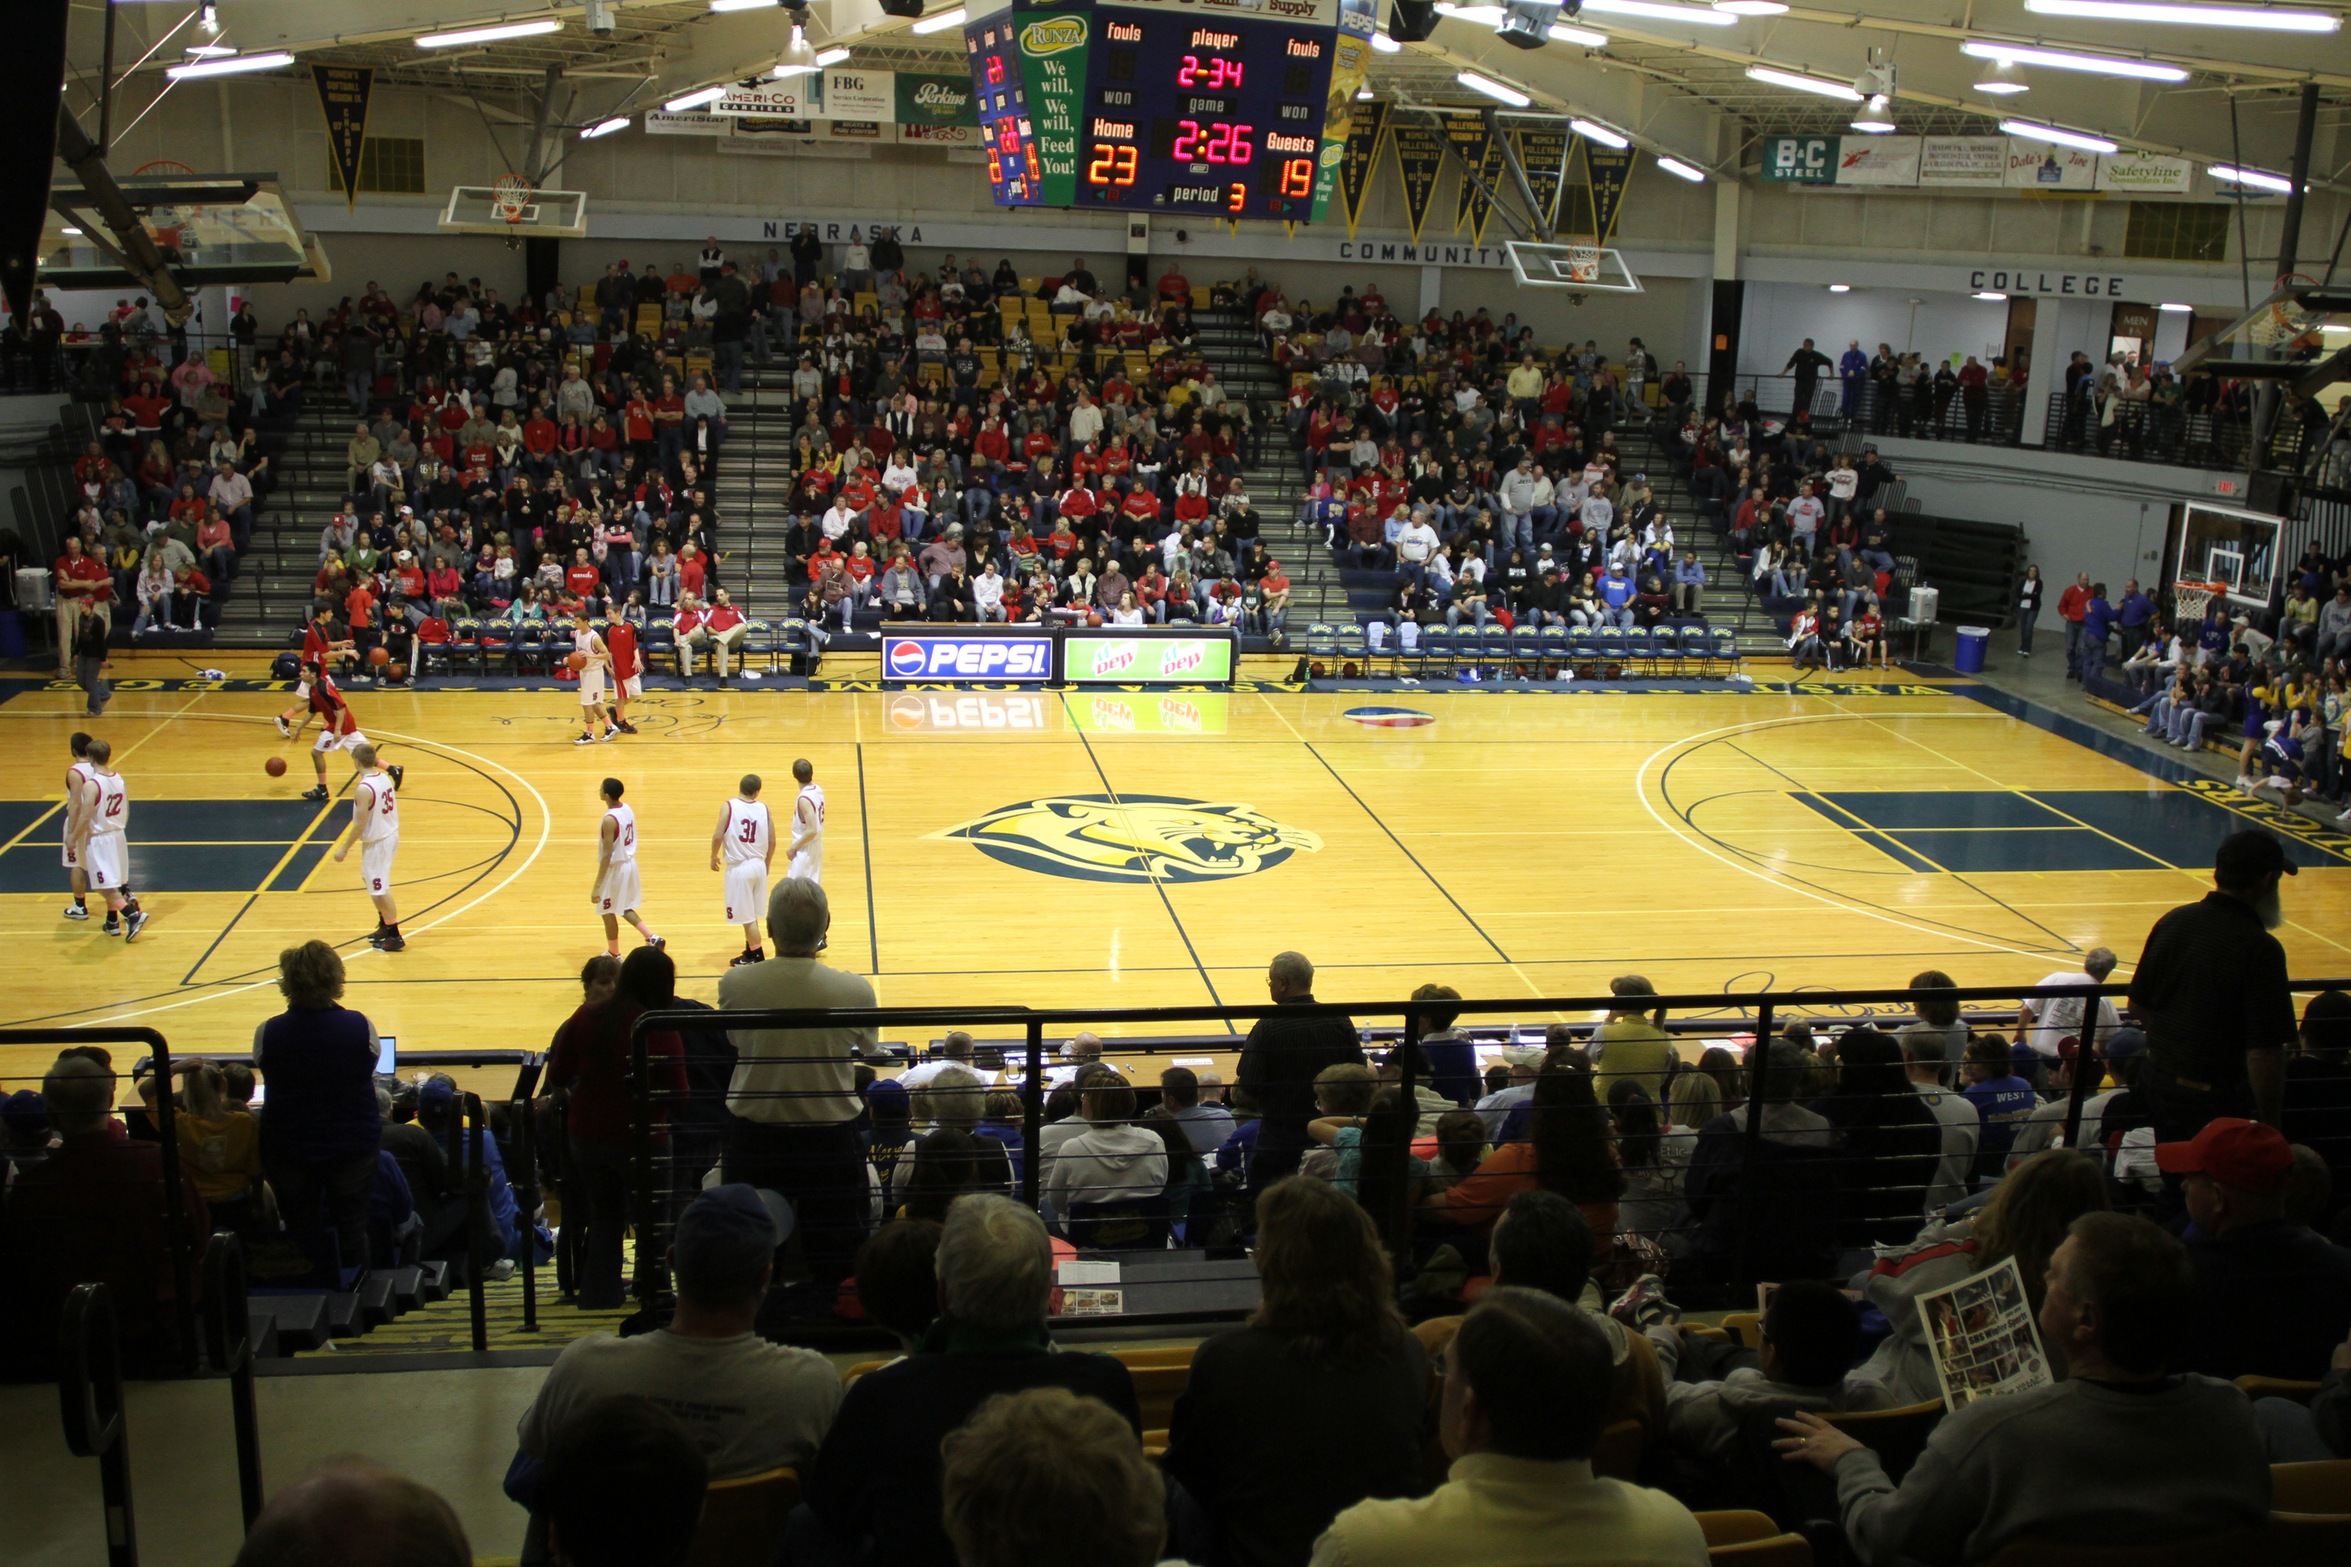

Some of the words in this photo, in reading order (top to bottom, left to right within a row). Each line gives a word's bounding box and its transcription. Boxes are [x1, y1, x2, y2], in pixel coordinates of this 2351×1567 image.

[1270, 0, 1317, 16] Supply
[1341, 9, 1376, 34] PEPSI
[1031, 27, 1081, 45] RUNZA
[1107, 22, 1142, 41] fouls
[1191, 28, 1239, 49] player
[1287, 38, 1320, 57] fouls
[1043, 60, 1066, 75] We
[1178, 55, 1244, 88] 2-34
[833, 76, 864, 90] FBG
[1041, 78, 1073, 94] will,
[914, 82, 966, 105] Perkins
[1104, 90, 1132, 105] won
[722, 104, 792, 113] CARRIERS
[1045, 99, 1067, 114] We
[1189, 98, 1225, 113] game
[1282, 105, 1308, 119] won
[648, 113, 729, 123] AmeriStar
[1042, 116, 1075, 132] will,
[1093, 118, 1134, 139] Home
[1041, 137, 1075, 153] Feed
[1173, 120, 1254, 164] 2:26
[1267, 132, 1315, 153] Guests
[1399, 141, 1440, 150] VOLLEYBAL
[1524, 146, 1563, 154] VOLLEYBAL
[1776, 139, 1827, 168] B&C
[2010, 152, 2043, 169] Dale's
[1043, 158, 1075, 174] You!
[1089, 143, 1138, 186] 23
[1350, 140, 1358, 194] CHAMPS
[2109, 164, 2182, 179] Safetyline
[1280, 159, 1313, 197] 19
[1775, 168, 1824, 178] STEEL
[1415, 162, 1423, 210] CHAMPS
[1539, 166, 1547, 209] CHAMP
[1173, 187, 1219, 202] period
[1228, 183, 1246, 211] 3
[1601, 170, 1611, 222] CHAMPS
[1340, 242, 1508, 266] COMMUNITY
[1971, 271, 2123, 296] COLLEGE
[2123, 315, 2149, 327] MEN
[457, 620, 480, 629] WNCC
[490, 620, 512, 629] WNCC
[523, 620, 545, 629] WNCC
[782, 619, 804, 629] WNCC
[1311, 625, 1332, 634] WNCC
[1341, 625, 1362, 634] WNCC
[1427, 626, 1448, 635] WNCC
[1457, 626, 1478, 636] WNCC
[1485, 626, 1506, 635] WNCC
[1628, 626, 1648, 636] WNCC
[1684, 626, 1704, 636] WNCC
[1713, 626, 1733, 637] WNCC
[928, 643, 1046, 675] PEPSI
[105, 793, 124, 817] 22
[381, 788, 394, 815] 35
[738, 818, 758, 843] 31
[1996, 1091, 2025, 1104] WEST
[2008, 1311, 2028, 1329] Sports
